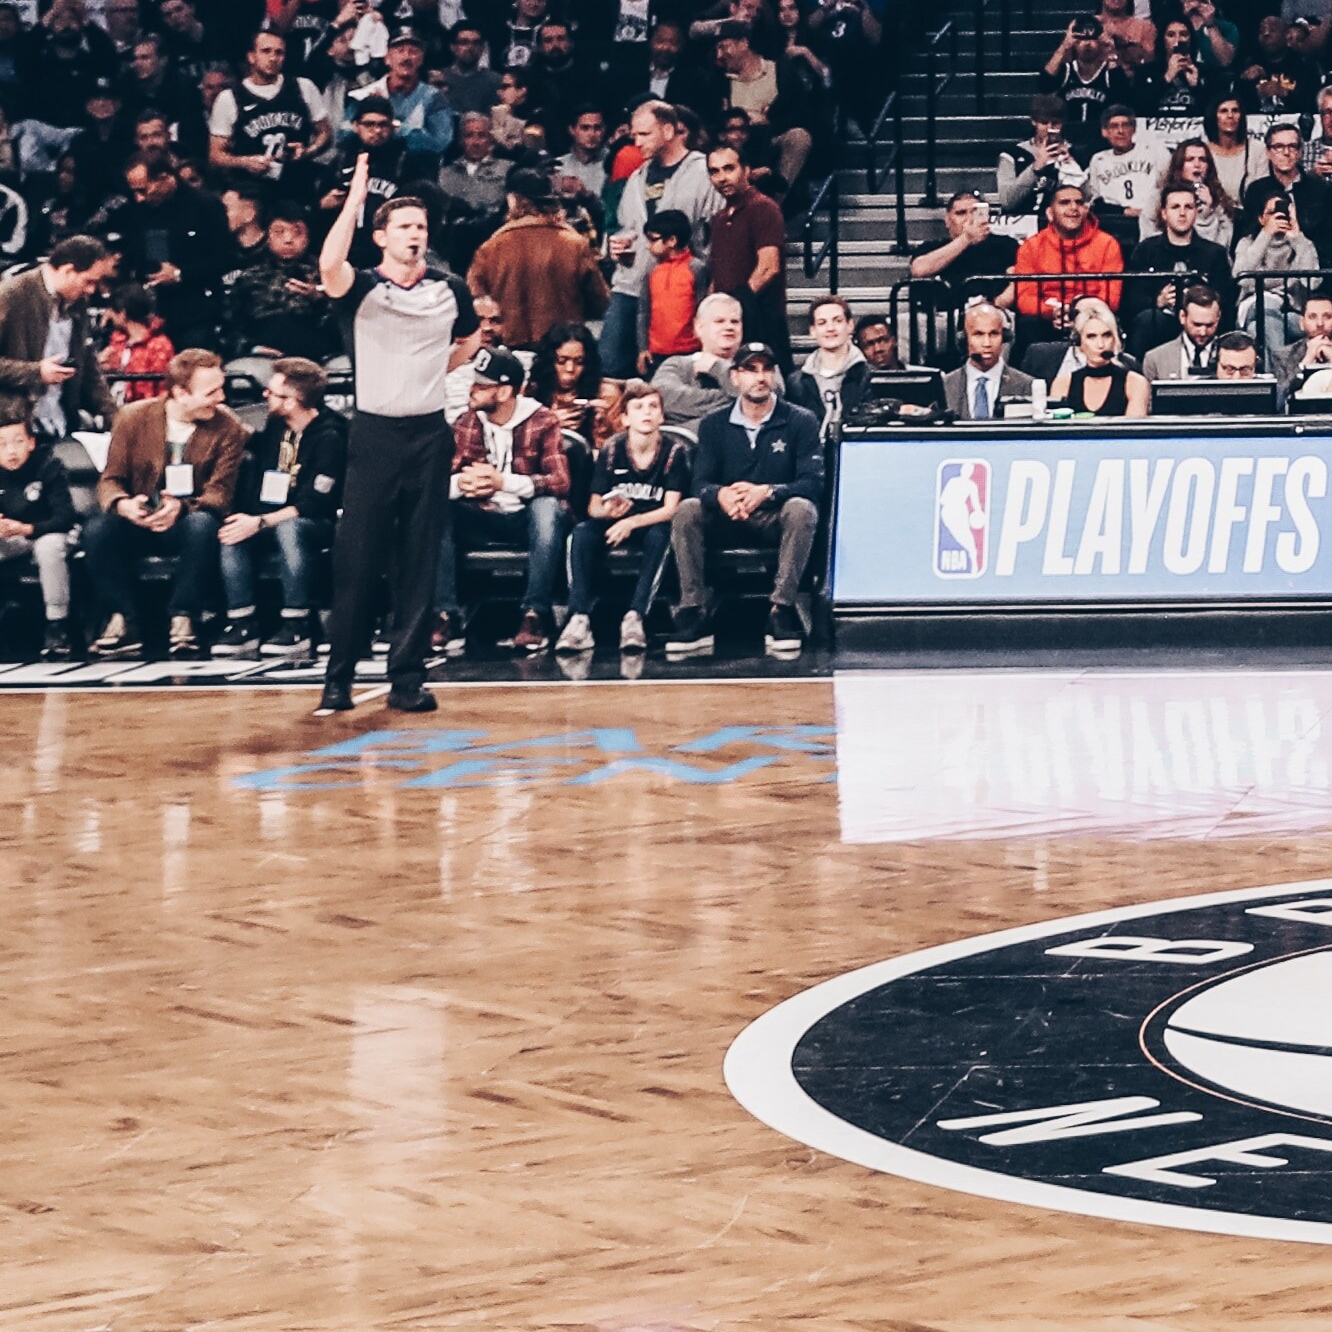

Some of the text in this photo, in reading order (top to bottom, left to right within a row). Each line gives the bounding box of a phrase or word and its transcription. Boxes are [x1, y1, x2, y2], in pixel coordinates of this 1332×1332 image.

[1096, 159, 1151, 185] BROOKLYN
[1123, 179, 1134, 200] 8
[996, 455, 1329, 577] PLAYOFFS
[940, 549, 968, 571] NBA
